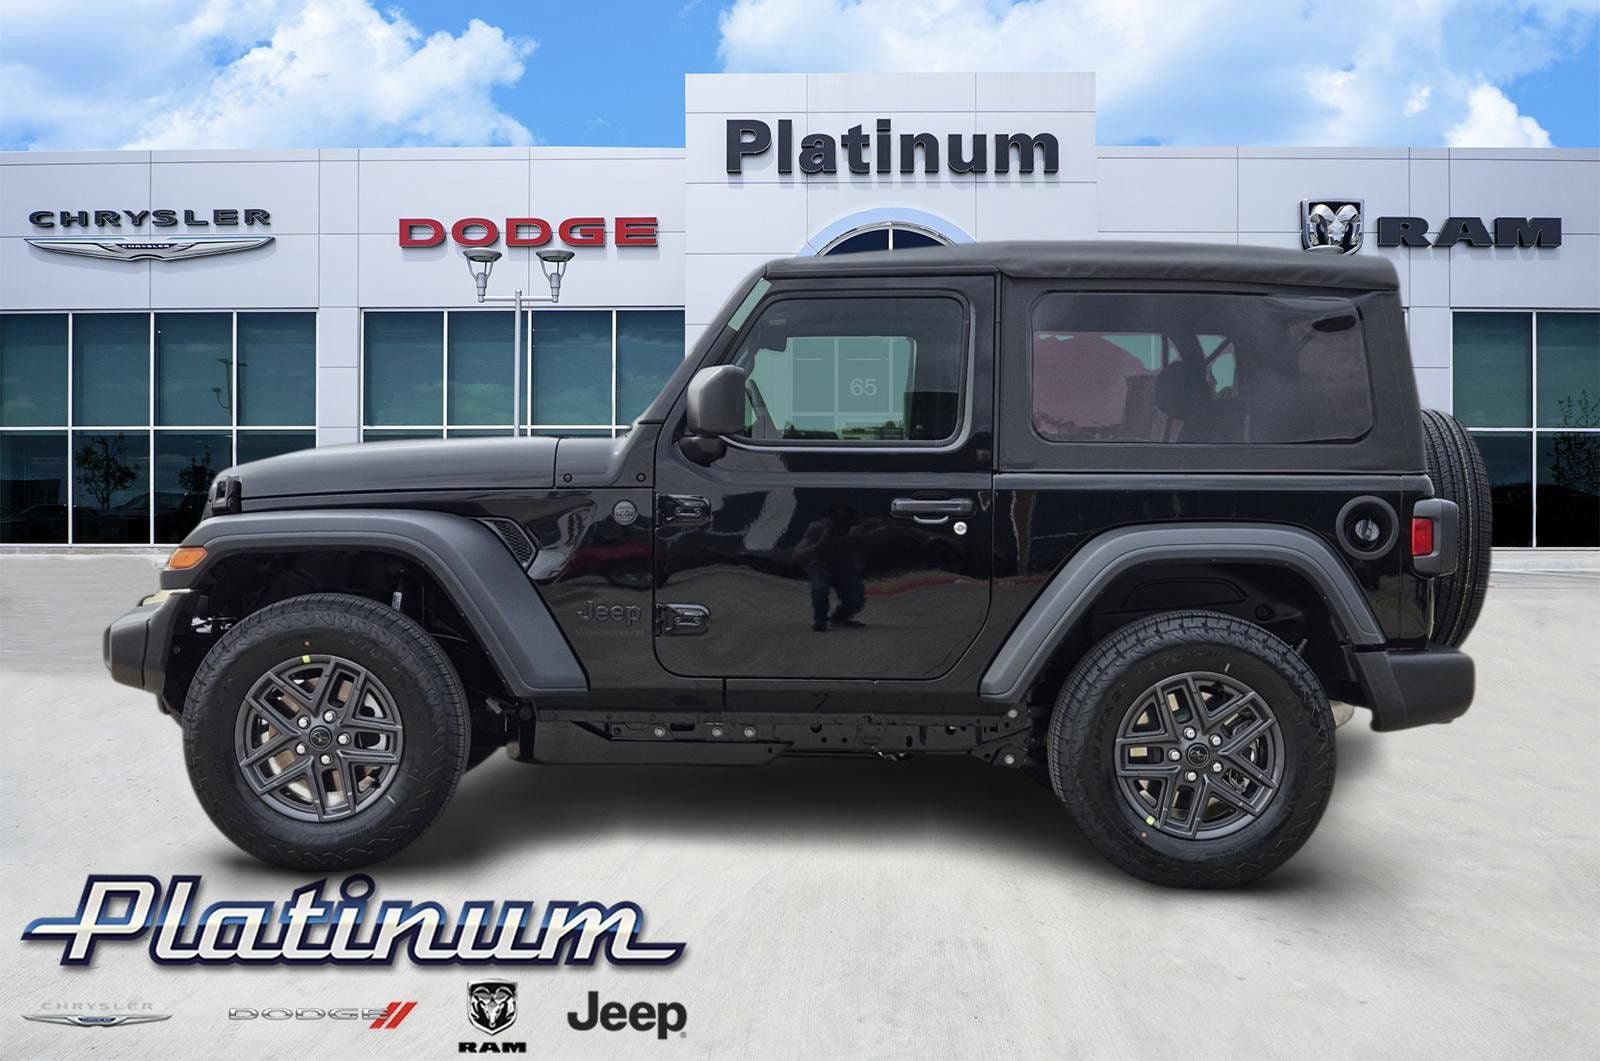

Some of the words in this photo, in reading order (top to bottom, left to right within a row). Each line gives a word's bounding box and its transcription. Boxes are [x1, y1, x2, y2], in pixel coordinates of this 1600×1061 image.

[726, 119, 1059, 175] Platinum
[28, 208, 272, 229] CHRYSLER
[399, 217, 658, 248] DODGE
[1377, 216, 1562, 248] RAM
[850, 378, 877, 397] 65
[576, 600, 641, 627] Jeep
